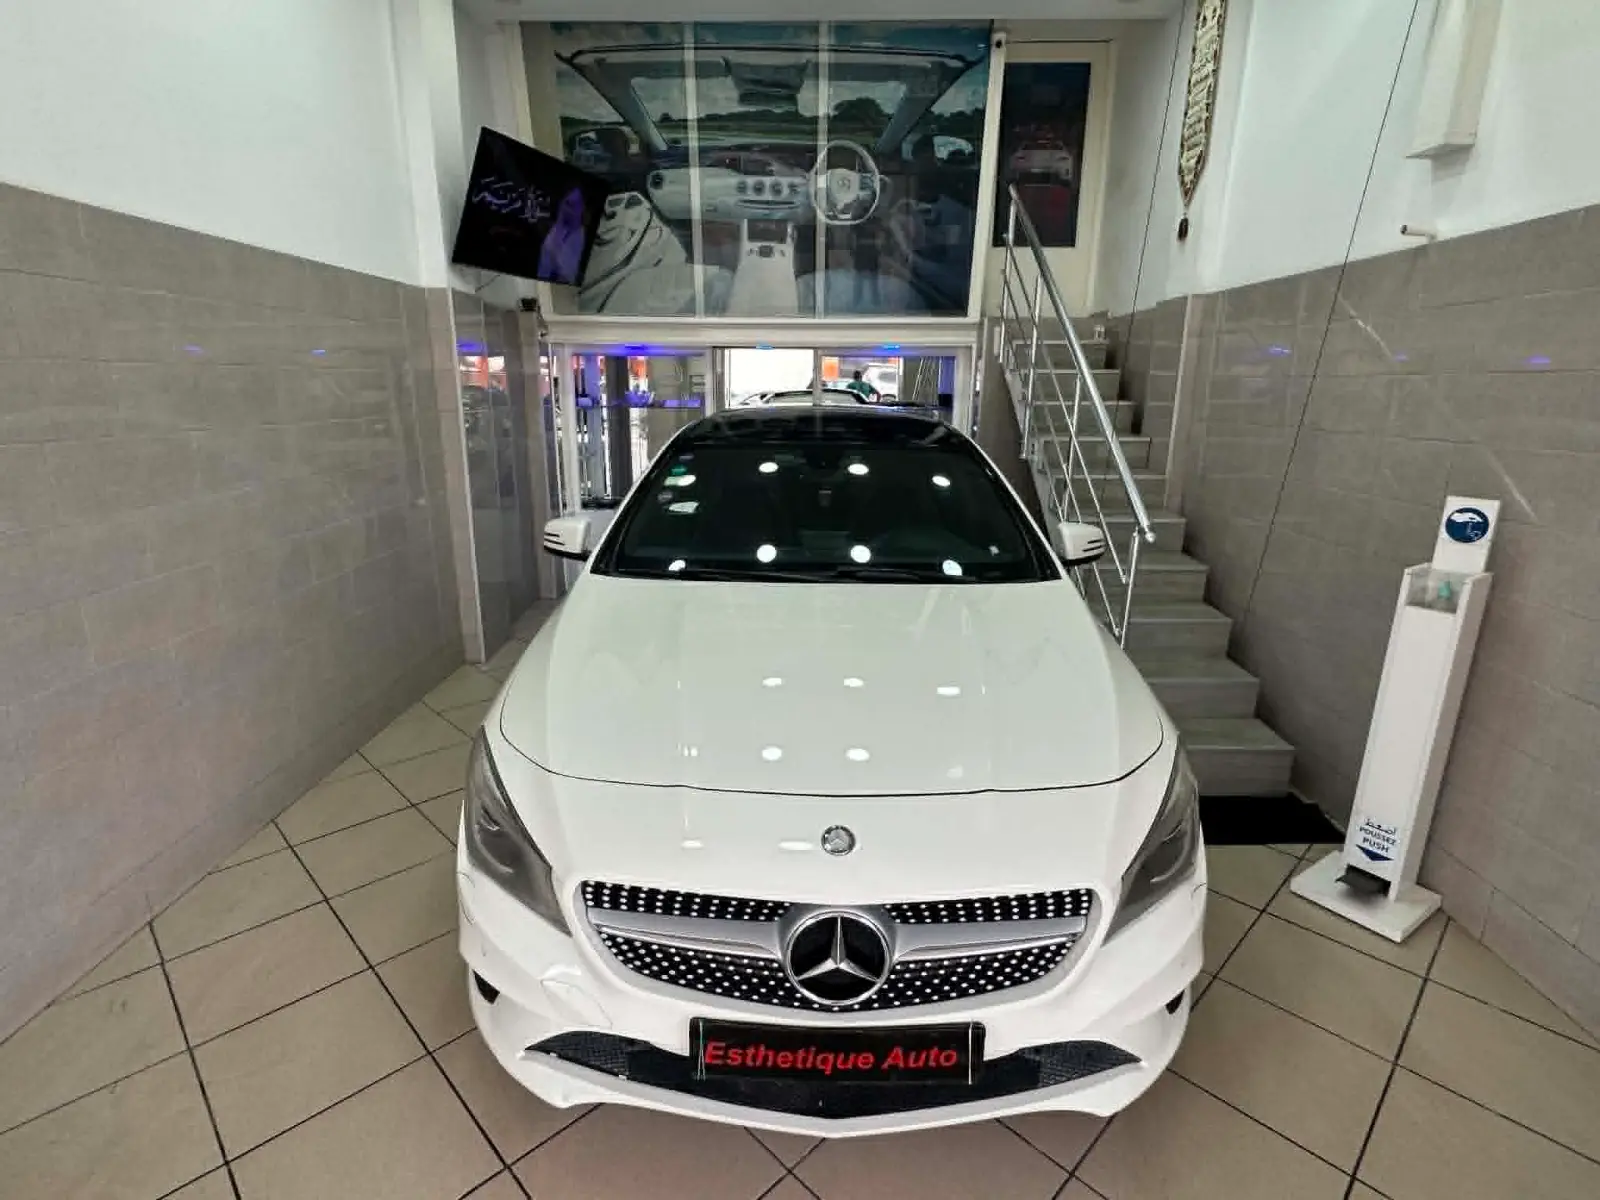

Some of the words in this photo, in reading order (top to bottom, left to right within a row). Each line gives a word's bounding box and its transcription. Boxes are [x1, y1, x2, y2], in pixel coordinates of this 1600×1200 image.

[1359, 826, 1397, 846] POUSSEZ
[1362, 837, 1389, 853] PUSH
[703, 1041, 874, 1075] Esthetique
[881, 1046, 958, 1070] Auto
